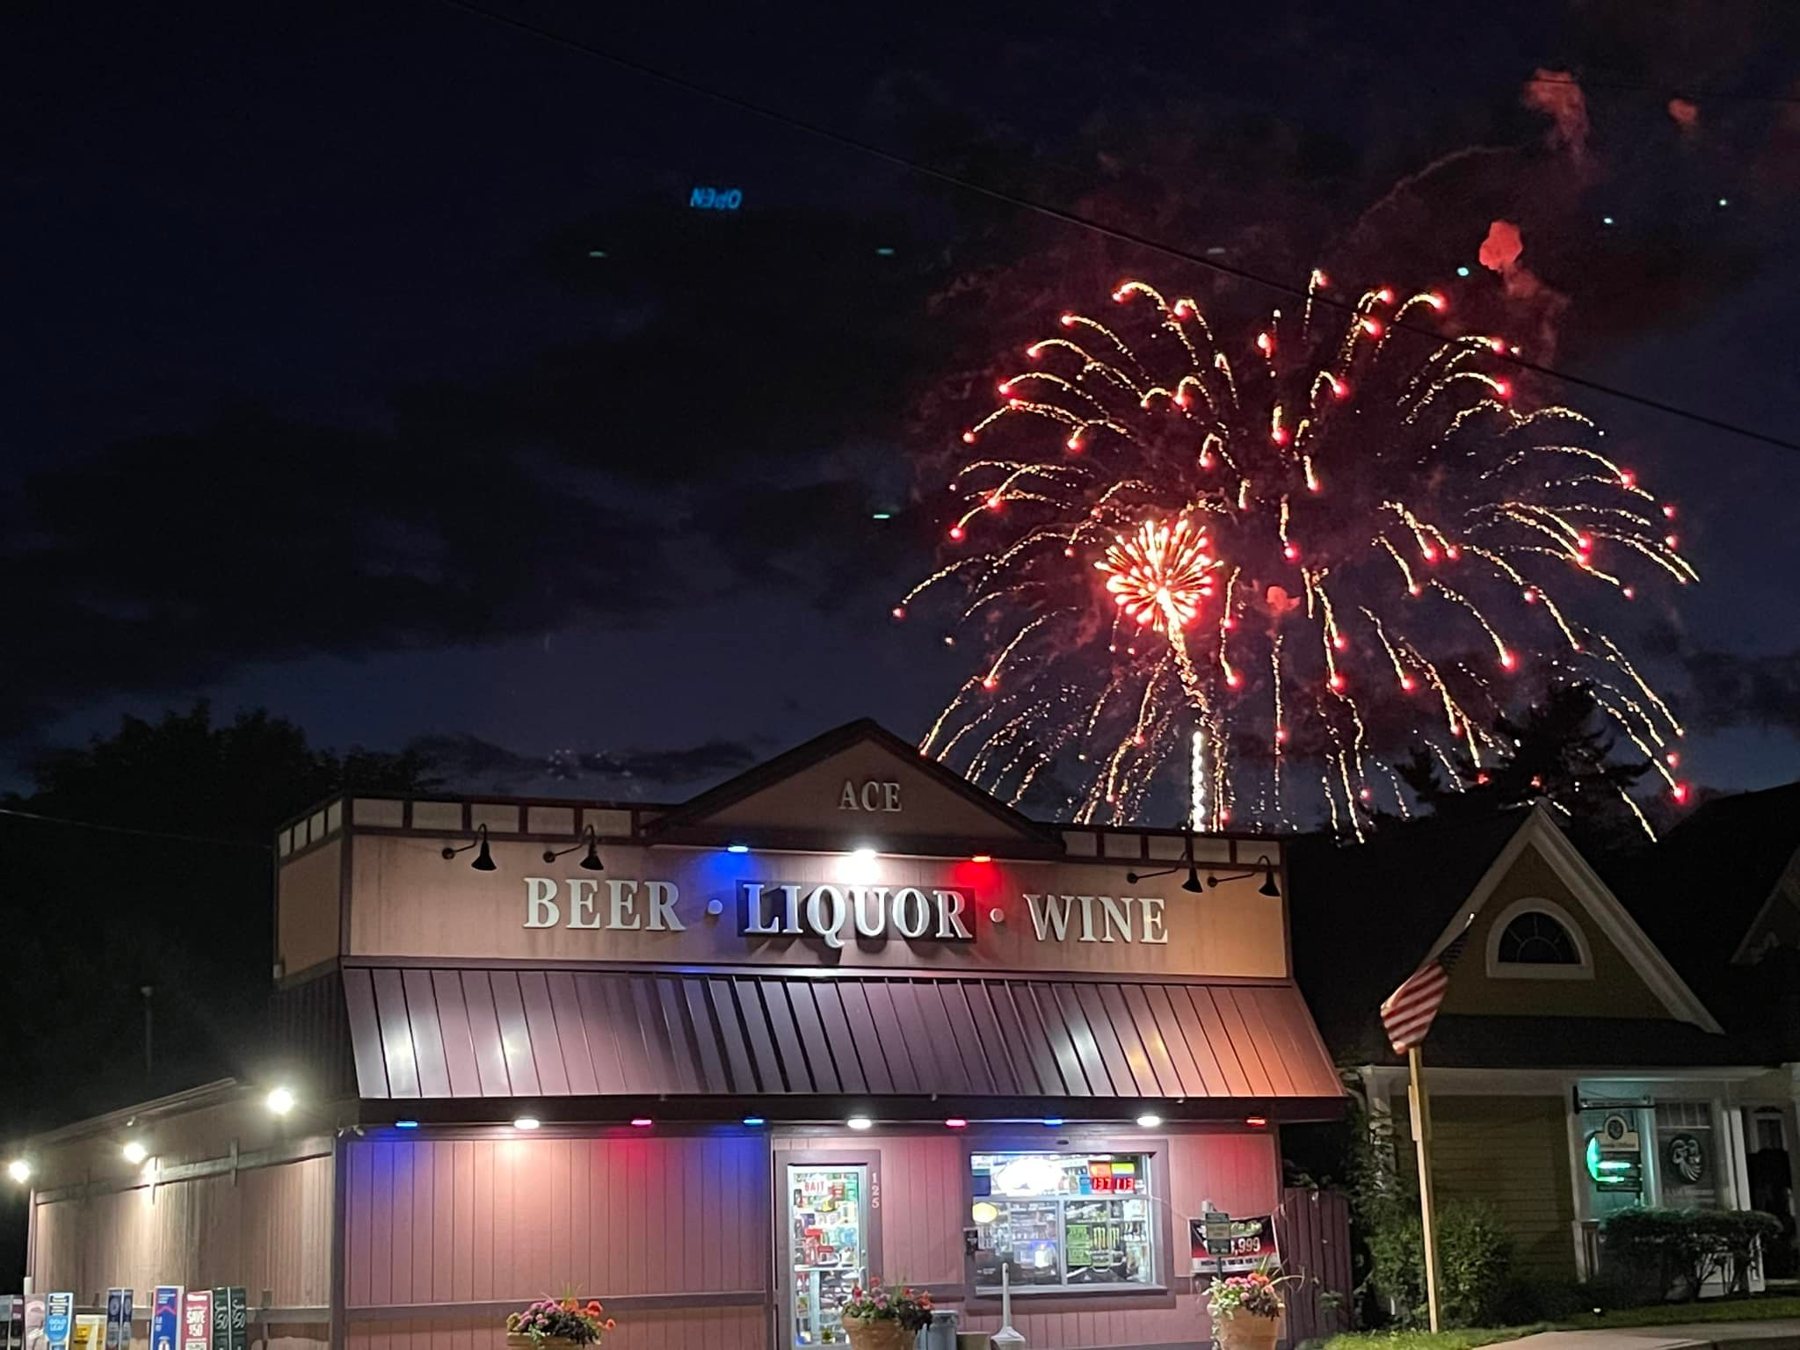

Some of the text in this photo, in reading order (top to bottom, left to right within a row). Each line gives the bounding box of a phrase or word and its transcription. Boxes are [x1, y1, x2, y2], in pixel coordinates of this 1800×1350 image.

[839, 781, 902, 812] ACE
[523, 876, 1169, 950] BEER LIQUOR WINE
[871, 1172, 880, 1209] 125
